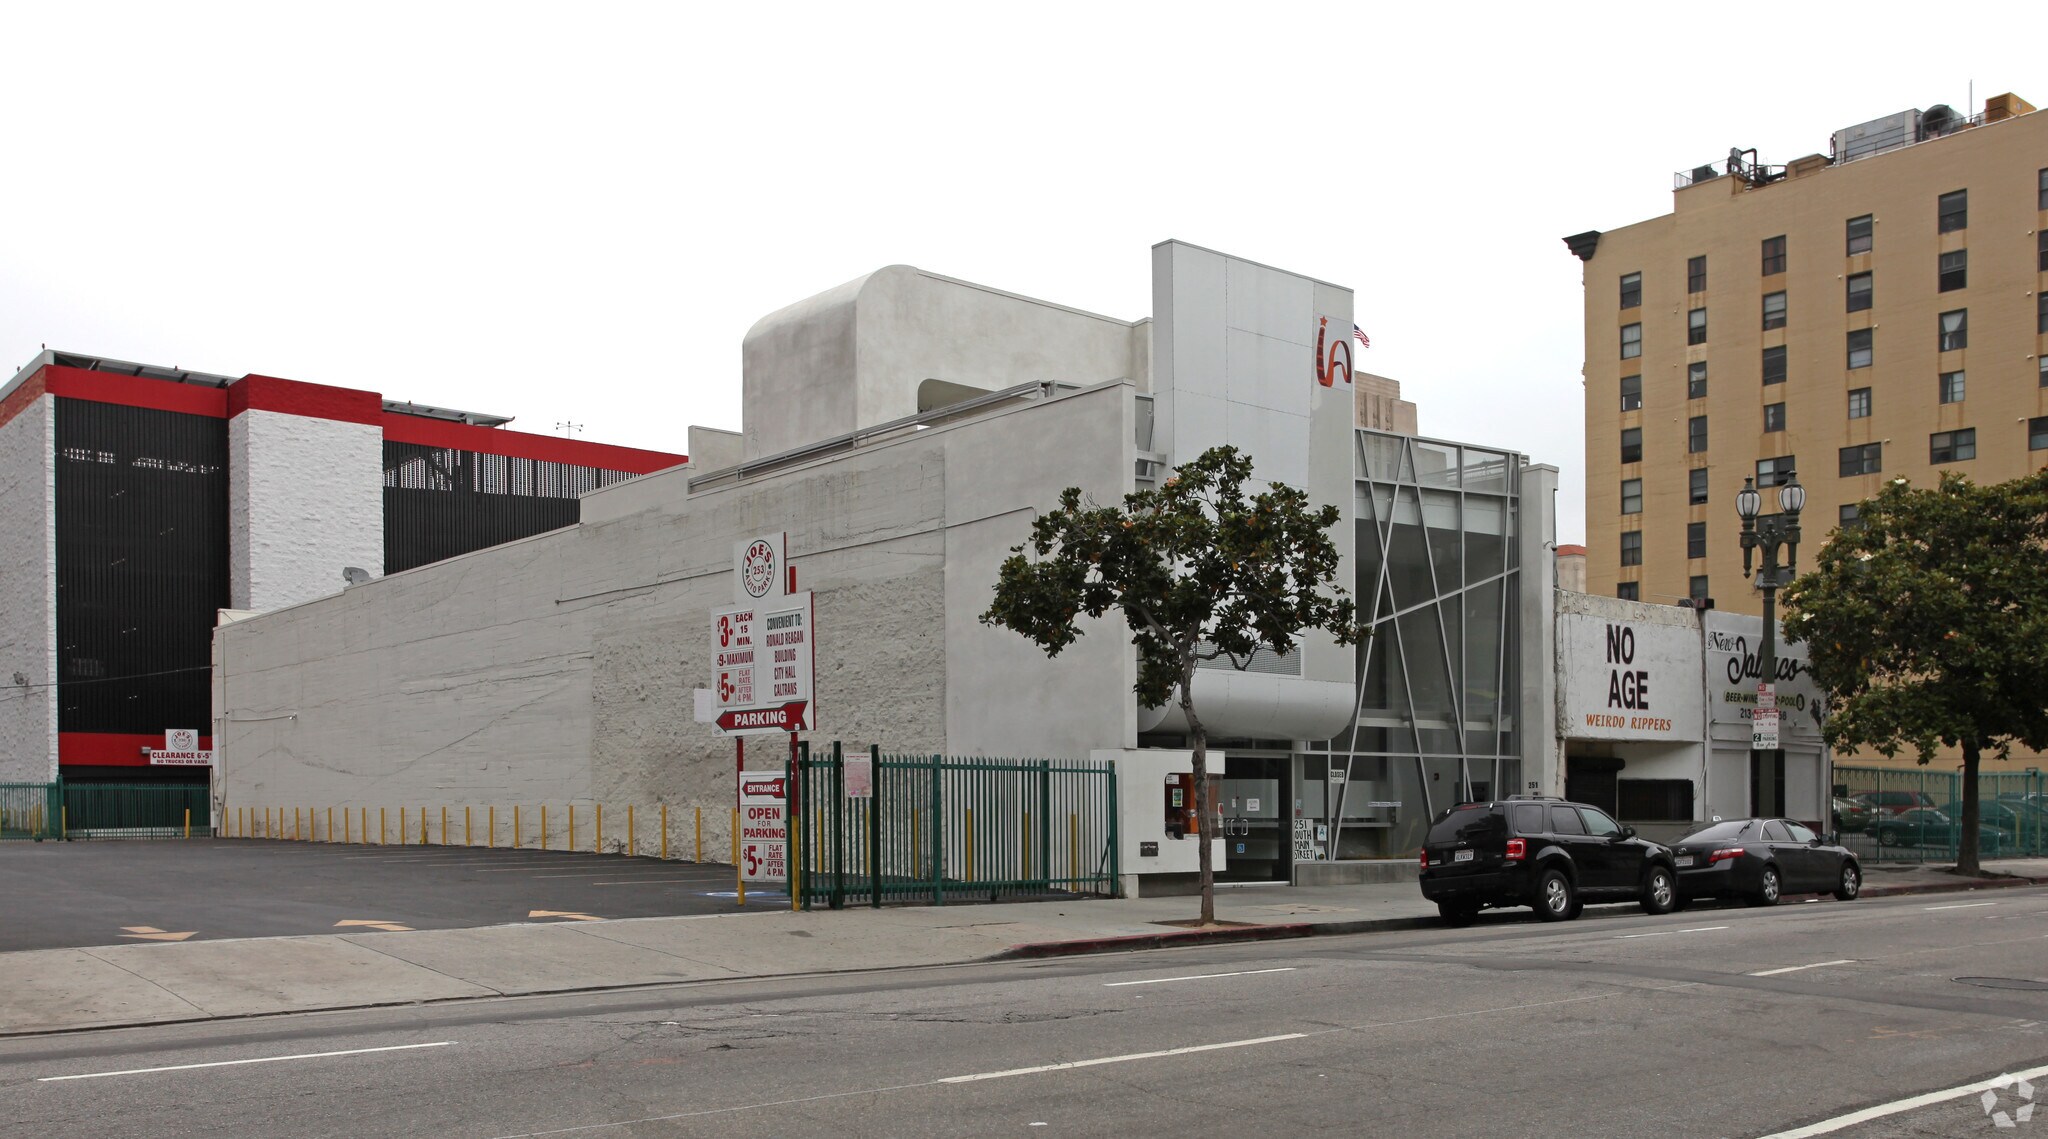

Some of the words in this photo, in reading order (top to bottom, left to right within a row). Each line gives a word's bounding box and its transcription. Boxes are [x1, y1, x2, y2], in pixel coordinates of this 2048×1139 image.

[746, 544, 772, 567] JOE'S
[753, 565, 764, 575] 253
[746, 575, 756, 593] AUTO
[758, 571, 772, 593] PARKS
[736, 613, 752, 622] EACH
[767, 615, 794, 630] CONVENIENT
[741, 625, 748, 634] 15
[736, 636, 752, 646] MIN.
[766, 632, 784, 647] RONALD
[785, 630, 803, 645] REAGAN
[1606, 624, 1634, 665] NO
[1708, 631, 1735, 651] New
[727, 651, 754, 665] MAXIMUM
[774, 648, 796, 663] BUILDING
[774, 667, 784, 680] CITY
[786, 666, 796, 679] HALL
[774, 682, 797, 696] CALTRANS
[1608, 669, 1649, 710] AGE
[735, 710, 786, 726] PARKING
[1586, 714, 1625, 728] WEIRDO
[1631, 717, 1672, 731] RIPPERS
[748, 808, 780, 819] OPEN
[1295, 820, 1307, 829] 251
[744, 828, 785, 838] PARKING
[1295, 841, 1310, 849] MAIN
[767, 868, 771, 876] 4
